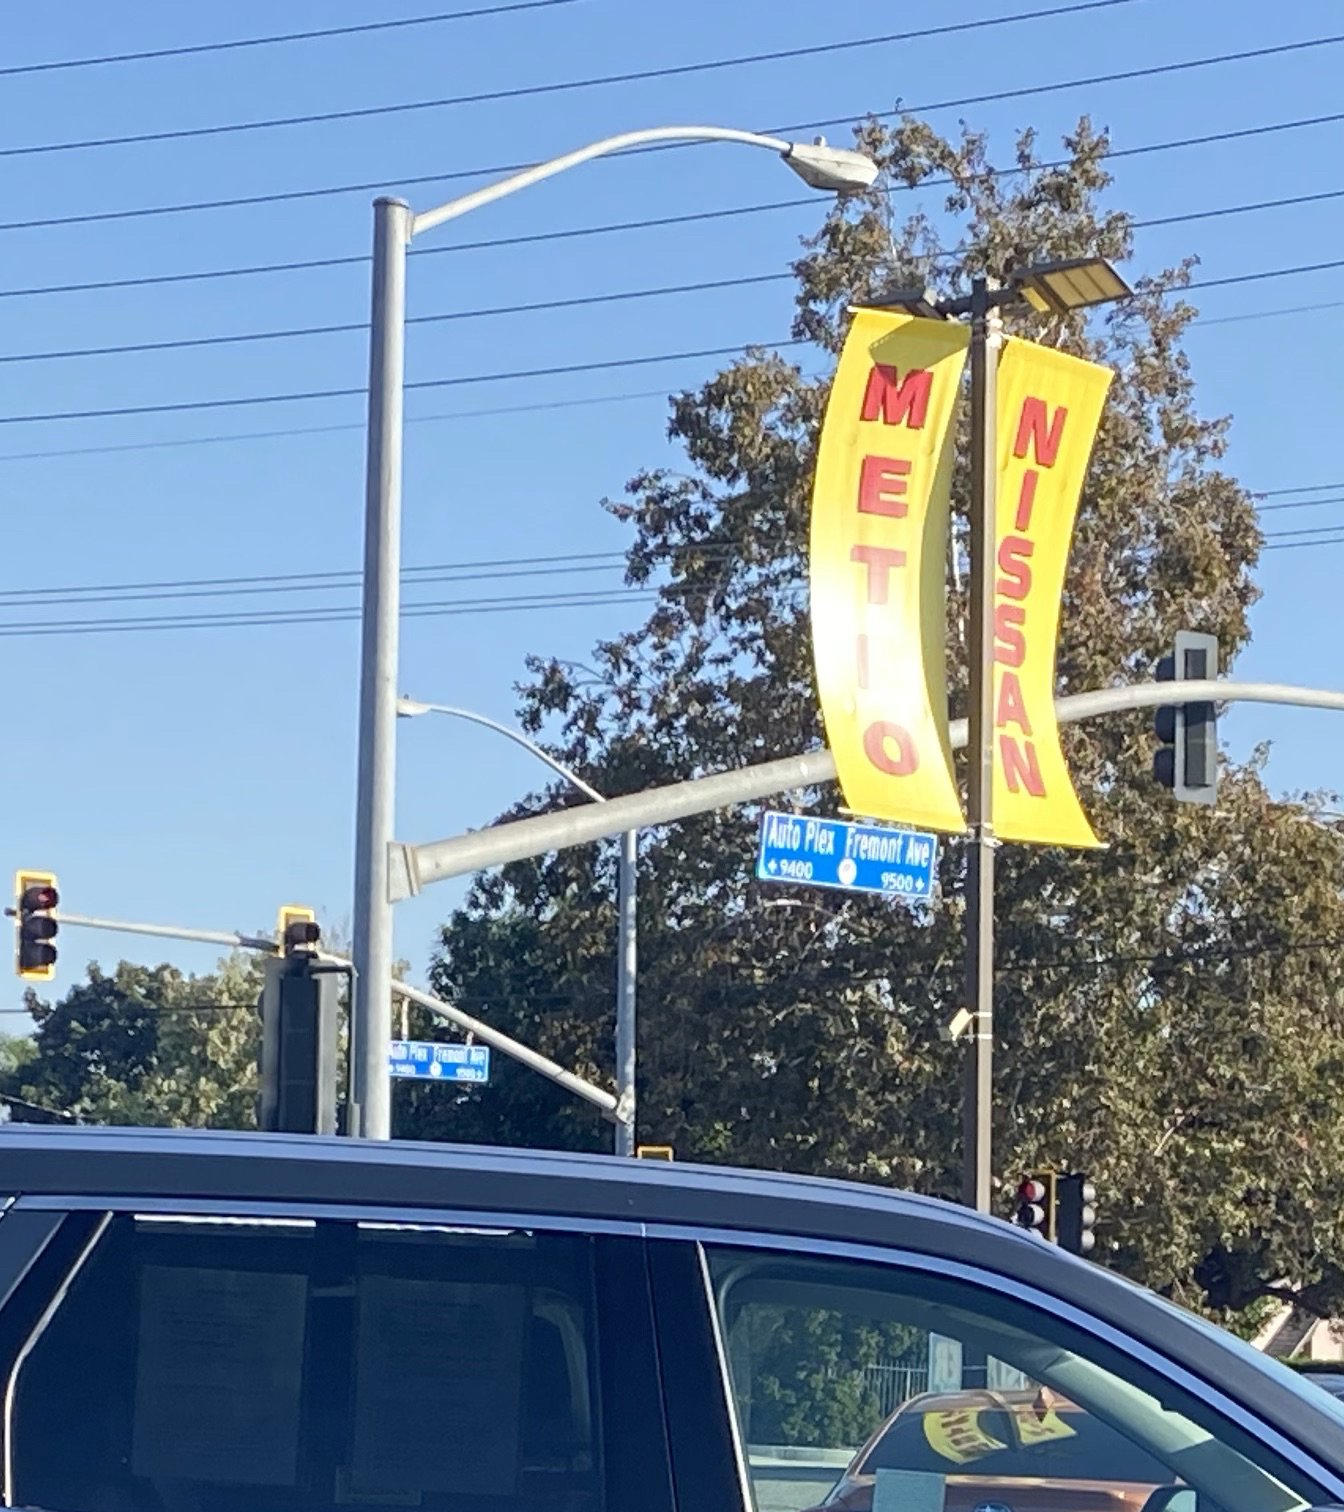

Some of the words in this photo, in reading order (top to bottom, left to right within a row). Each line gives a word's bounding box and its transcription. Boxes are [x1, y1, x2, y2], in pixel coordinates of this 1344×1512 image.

[850, 365, 933, 778] METO
[993, 396, 1068, 797] NISSAN
[768, 816, 801, 851] Auto
[805, 823, 835, 855] Plex
[845, 827, 903, 865] Fremont
[906, 839, 931, 868] Ave
[779, 859, 814, 881] 9400
[880, 872, 914, 892] 9500
